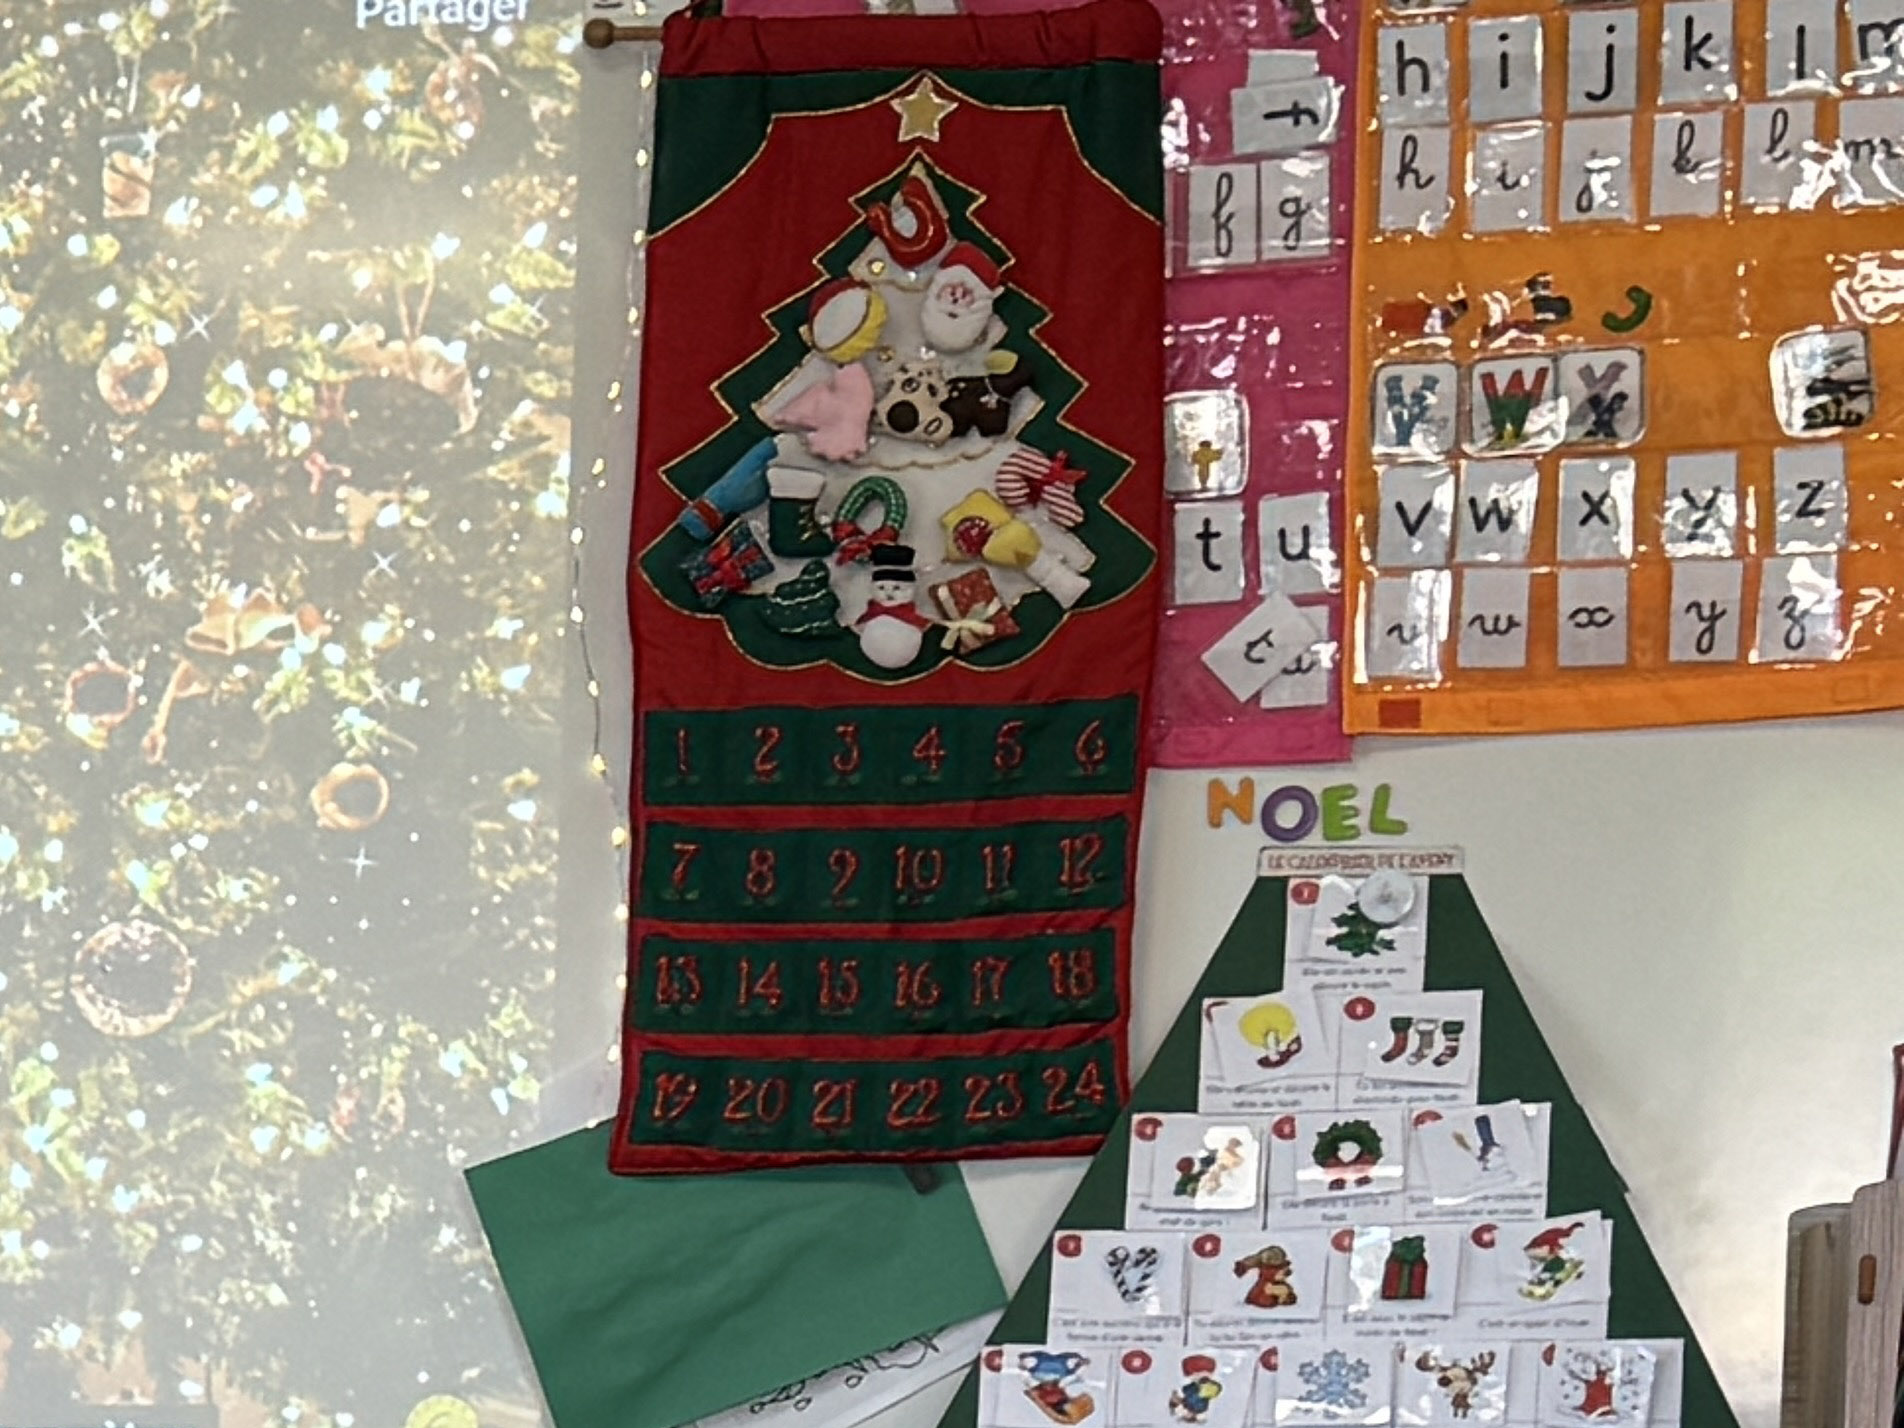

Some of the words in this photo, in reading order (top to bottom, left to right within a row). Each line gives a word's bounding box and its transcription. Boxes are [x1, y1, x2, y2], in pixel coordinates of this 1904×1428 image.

[356, 0, 526, 32] Partager
[1395, 39, 1431, 96] h
[1498, 33, 1510, 89] i
[1584, 25, 1617, 102] j
[1684, 16, 1714, 72] k
[1395, 134, 1435, 190] h
[1278, 195, 1312, 252] g
[1480, 366, 1550, 444] W
[1395, 500, 1434, 538] v
[1467, 495, 1514, 533] w
[1579, 489, 1612, 526] x
[1797, 480, 1826, 518] z
[1195, 517, 1223, 572] t
[1278, 525, 1311, 562] u
[1568, 604, 1615, 630] x
[1685, 600, 1727, 655] y
[676, 726, 691, 775] 1
[753, 725, 782, 780] 2
[832, 722, 861, 774] 3
[913, 725, 946, 774] 4
[994, 720, 1025, 771] 5
[1075, 720, 1108, 774] 6
[1206, 776, 1408, 843] NOEL
[672, 842, 701, 890] 7
[745, 847, 777, 897] 8
[827, 847, 861, 896] 9
[895, 843, 944, 893] 10
[981, 841, 1017, 892] 11
[1059, 834, 1102, 894] 12
[655, 955, 703, 1007] 13
[737, 956, 783, 1010] 14
[817, 957, 861, 1010] 15
[895, 960, 942, 1010] 16
[971, 956, 1009, 1005] 17
[1048, 948, 1097, 1000] 18
[653, 1072, 700, 1124] 19
[723, 1077, 788, 1125] 20
[812, 1078, 859, 1129] 21
[886, 1079, 943, 1130] 22
[964, 1071, 1024, 1124] 23
[1041, 1061, 1105, 1117] 24
